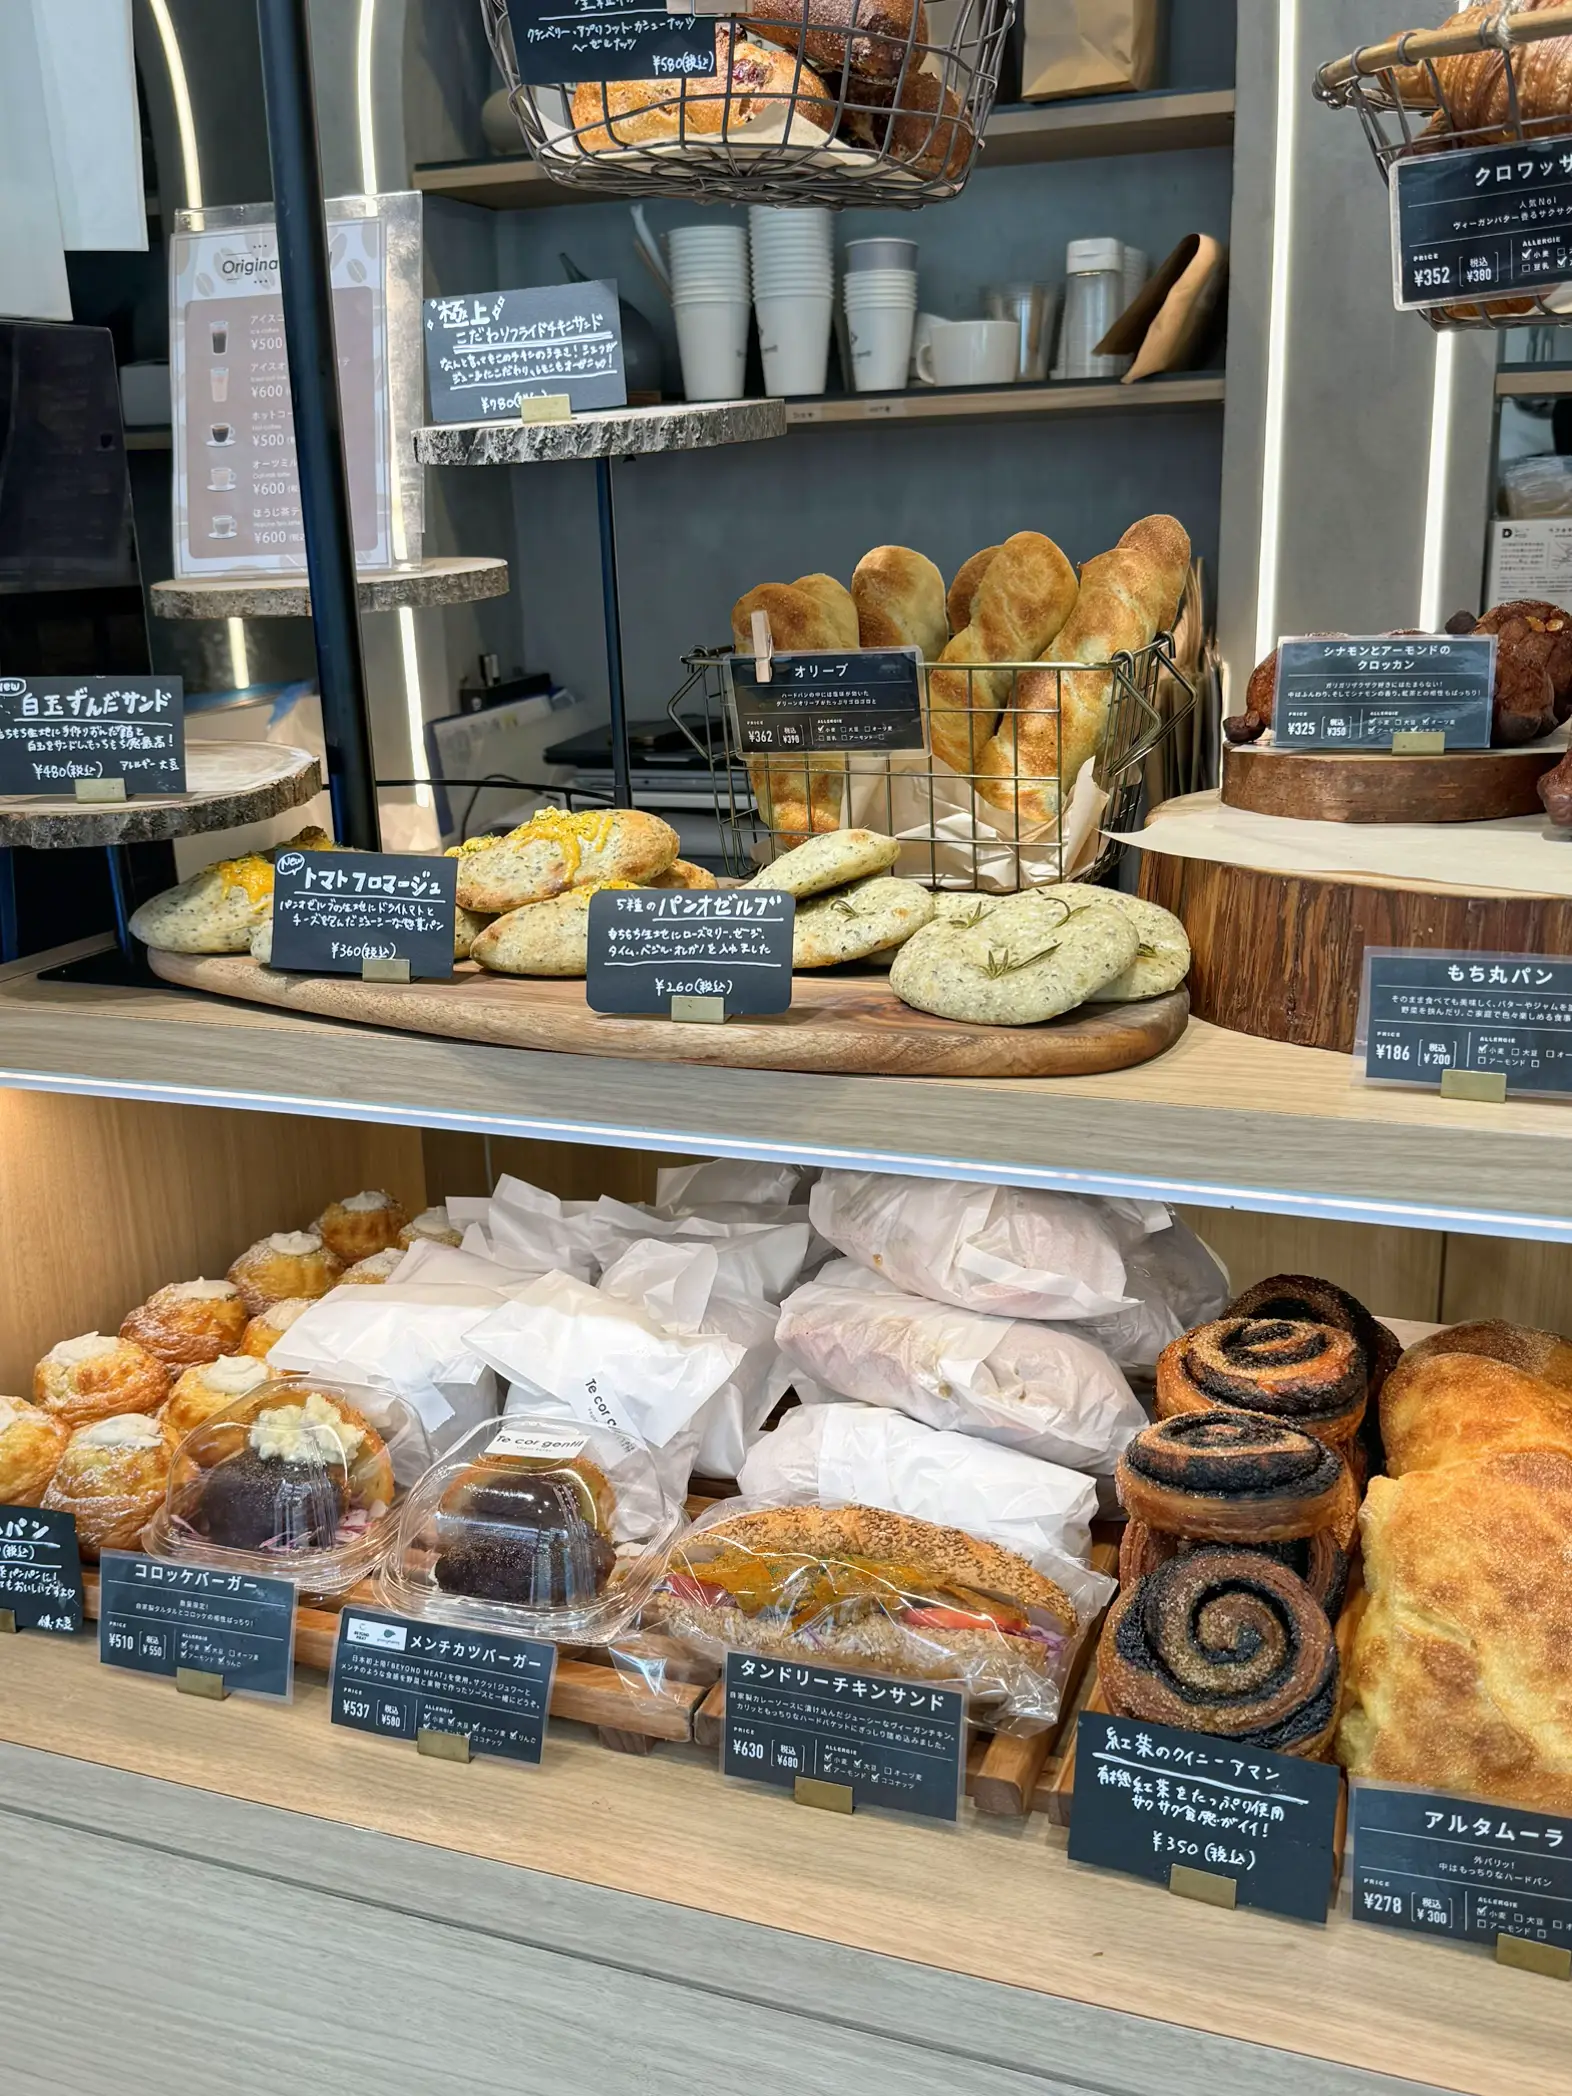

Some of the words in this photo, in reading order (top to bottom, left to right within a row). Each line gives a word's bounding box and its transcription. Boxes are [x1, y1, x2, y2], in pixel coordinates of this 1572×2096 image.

[1522, 236, 1561, 247] ALLERGIE
[1413, 253, 1439, 262] PRICE
[1470, 257, 1488, 268] 税込
[1414, 266, 1450, 287] ¥352
[1466, 268, 1492, 282] ¥380
[439, 300, 490, 326] 極上
[251, 337, 283, 351] ¥500
[251, 385, 283, 398] ¥600
[253, 434, 284, 447] ¥500
[253, 482, 285, 495] ¥600
[254, 531, 286, 544] ¥600
[1323, 645, 1450, 657] シナモンとアーモンドの
[795, 663, 849, 679] オリーブ
[1357, 660, 1415, 670] クロッカン
[22, 687, 172, 717] 白玉ずんだサンド
[1288, 722, 1316, 736] ¥325
[1327, 727, 1347, 737] ¥350
[748, 730, 773, 744] ¥362
[33, 760, 103, 780] ¥480(税込)
[304, 867, 442, 897] トマトフロマージュ
[331, 942, 397, 960] ¥360(税込)
[1448, 964, 1553, 985] もち丸パン
[655, 978, 733, 996] ¥260(税込)
[1480, 1036, 1516, 1044] ALLERGIE
[1376, 1044, 1410, 1061] ¥186
[585, 1378, 597, 1393] Te
[594, 1396, 611, 1415] cor
[0, 1517, 50, 1540] パン
[0, 1544, 35, 1560] (税込)
[135, 1563, 257, 1591] コロッケバーガー
[108, 1632, 134, 1650] ¥510
[410, 1635, 541, 1669] メンチカツバーガー
[343, 1687, 363, 1696] PRICE
[741, 1660, 944, 1711] タンドリーチキンサンド
[343, 1699, 370, 1719] ¥537
[424, 1704, 453, 1714] ALLERGIE
[381, 1714, 400, 1728] ¥580
[733, 1726, 755, 1735] PRICE
[733, 1738, 764, 1760] ¥630
[780, 1743, 796, 1756] 税込
[825, 1744, 857, 1756] ALLERGIE
[1104, 1726, 1280, 1781] 紅茶のクイニーアマン
[777, 1754, 798, 1769] ¥680
[1424, 1811, 1564, 1848] アルタムーラ
[1363, 1877, 1391, 1887] PRICE
[1363, 1892, 1403, 1914] ¥278
[1421, 1897, 1442, 1910] 税込
[1478, 1896, 1519, 1908] ALLERGIE
[1489, 1921, 1532, 1936] アーモンド
